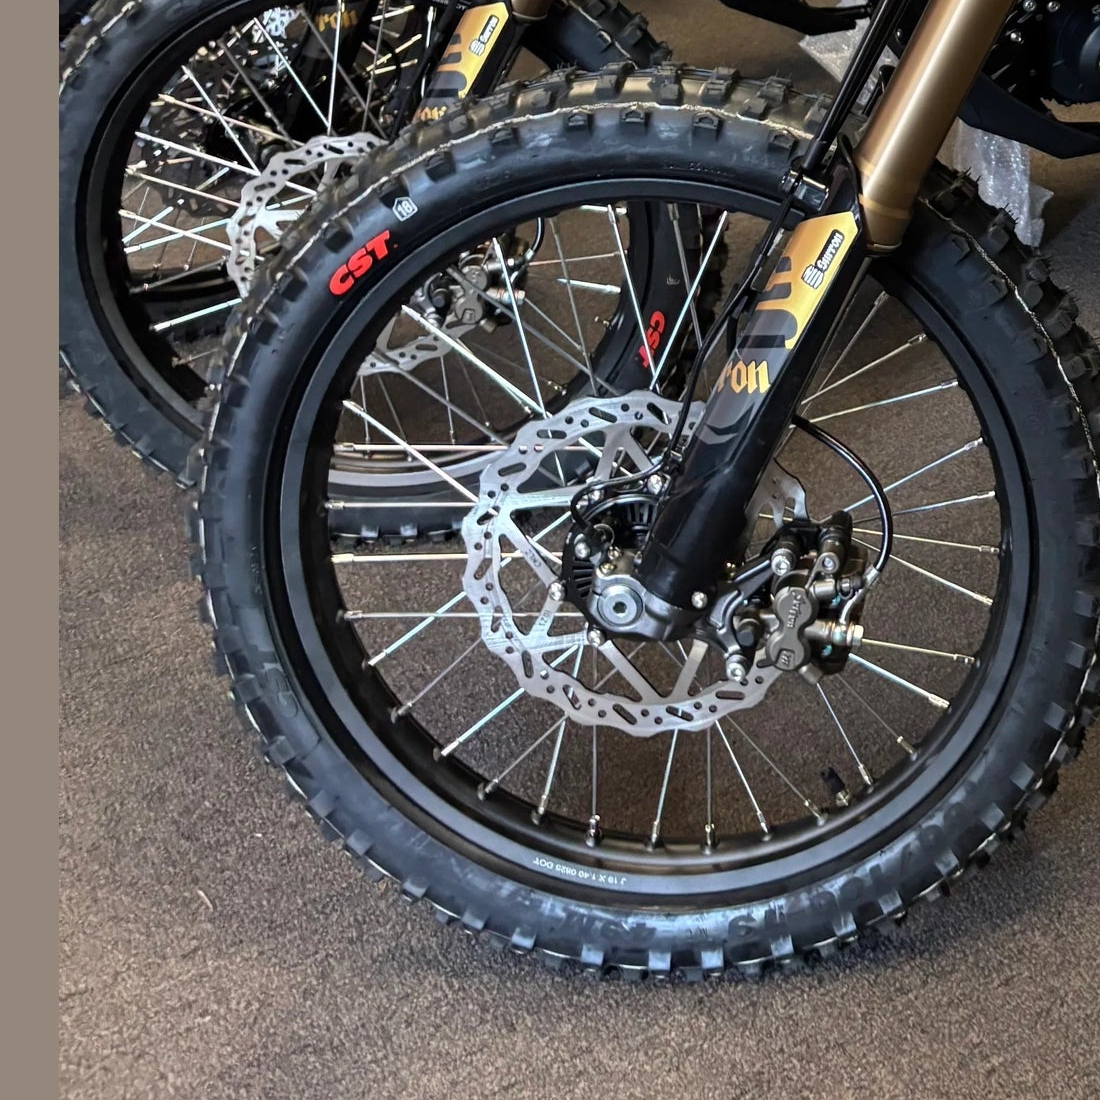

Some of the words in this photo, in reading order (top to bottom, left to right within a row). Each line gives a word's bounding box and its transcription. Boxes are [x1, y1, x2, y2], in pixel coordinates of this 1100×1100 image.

[329, 230, 390, 296] CST
[817, 232, 844, 271] Surron
[532, 857, 554, 869] DOT
[608, 875, 618, 884] 19
